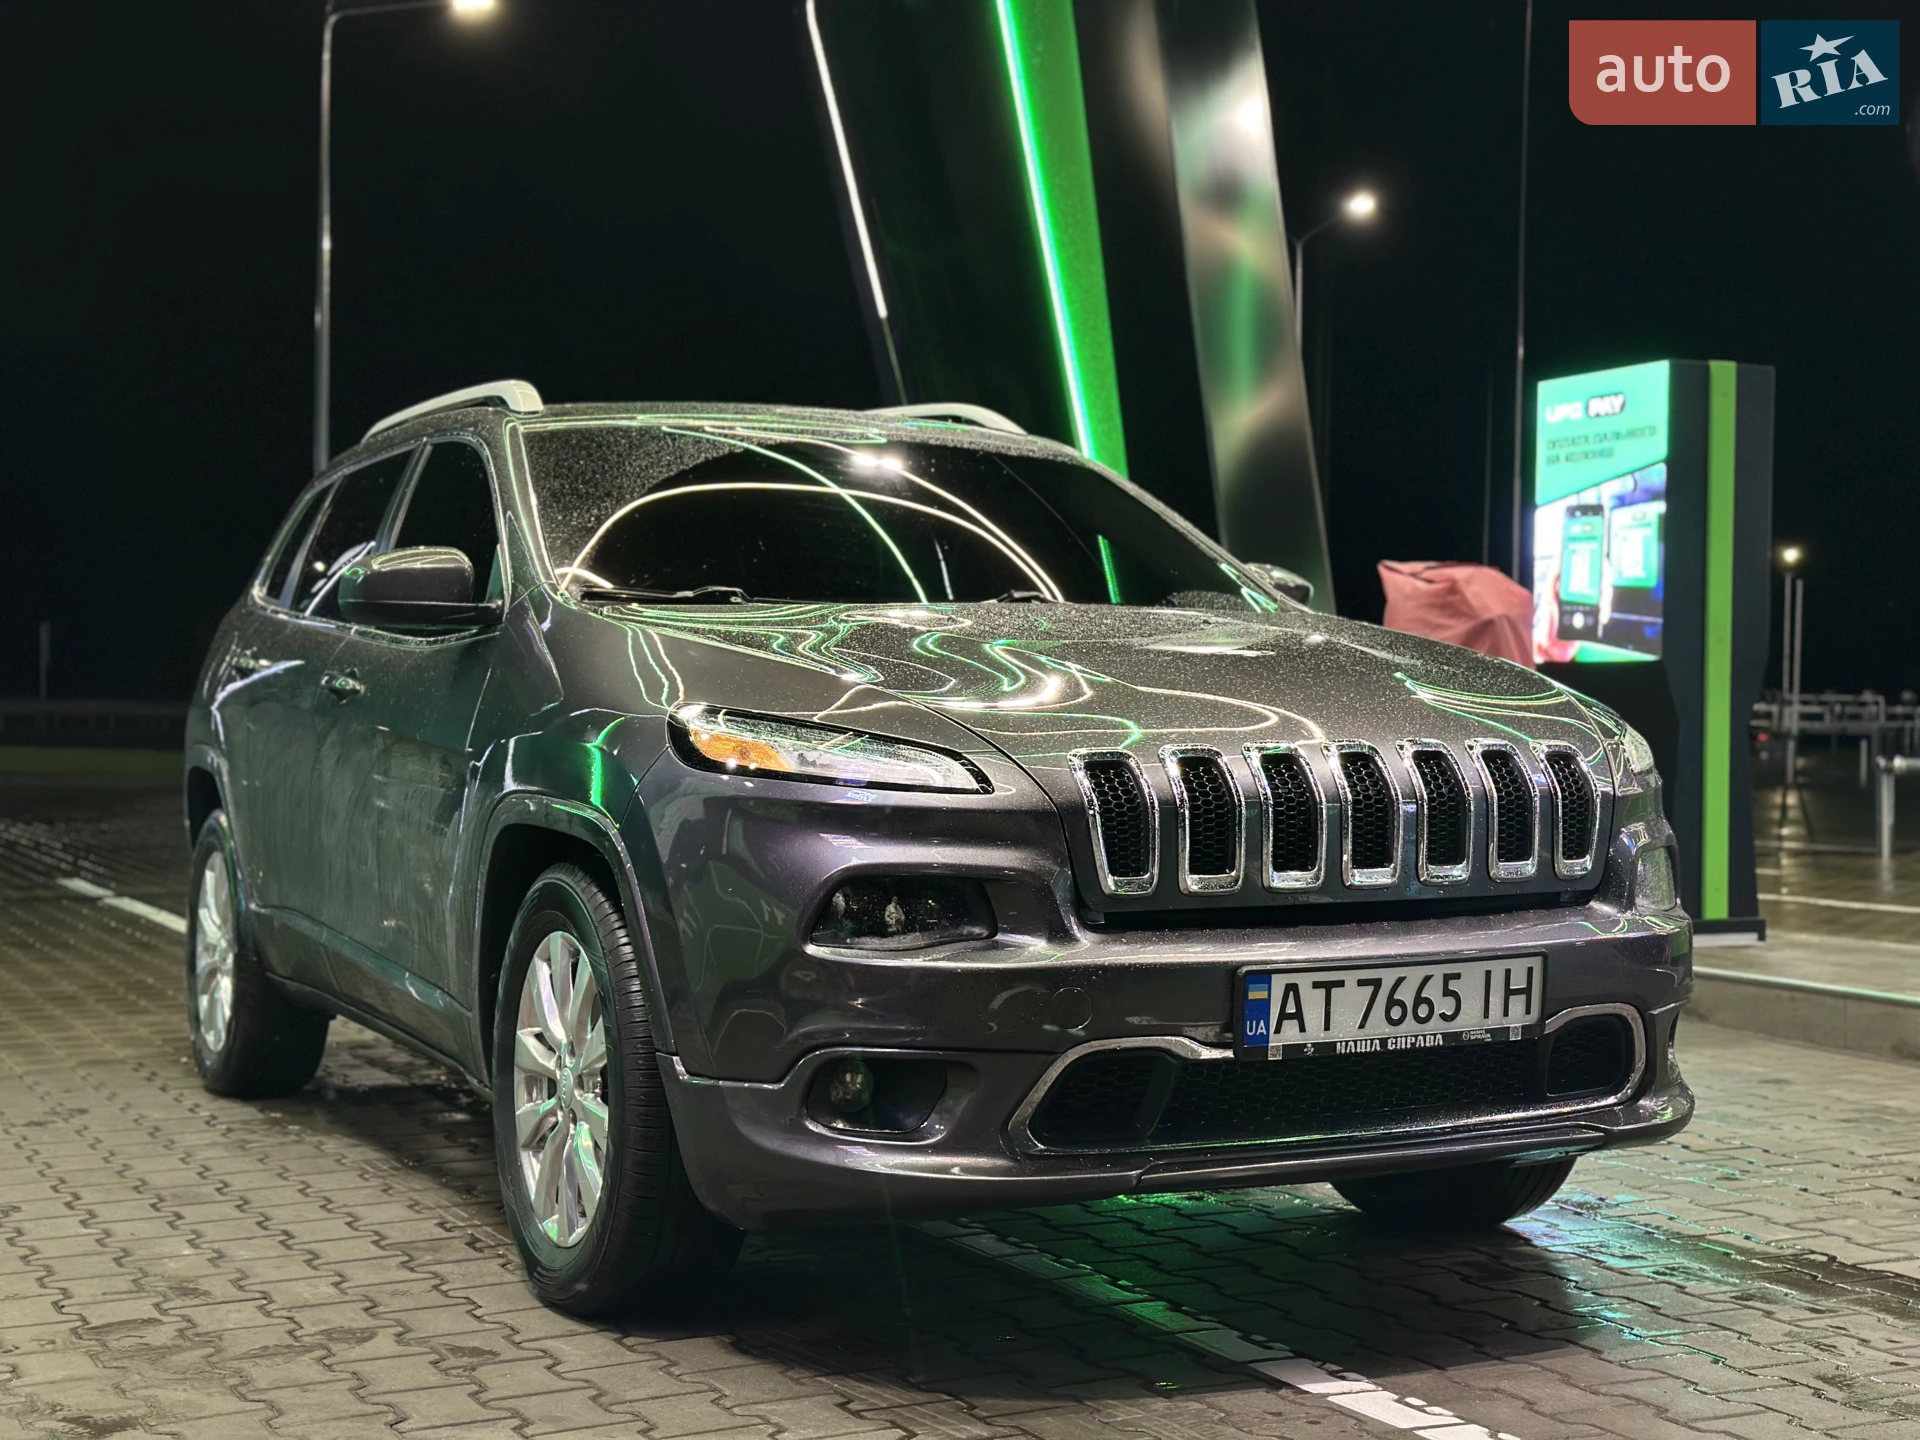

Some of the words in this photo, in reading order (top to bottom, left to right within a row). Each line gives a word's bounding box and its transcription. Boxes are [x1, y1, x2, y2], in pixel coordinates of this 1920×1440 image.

[1356, 971, 1462, 1030] 7665
[1246, 1021, 1267, 1036] UA
[1336, 1038, 1381, 1055] НАША
[1387, 1033, 1444, 1051] СПРАВА
